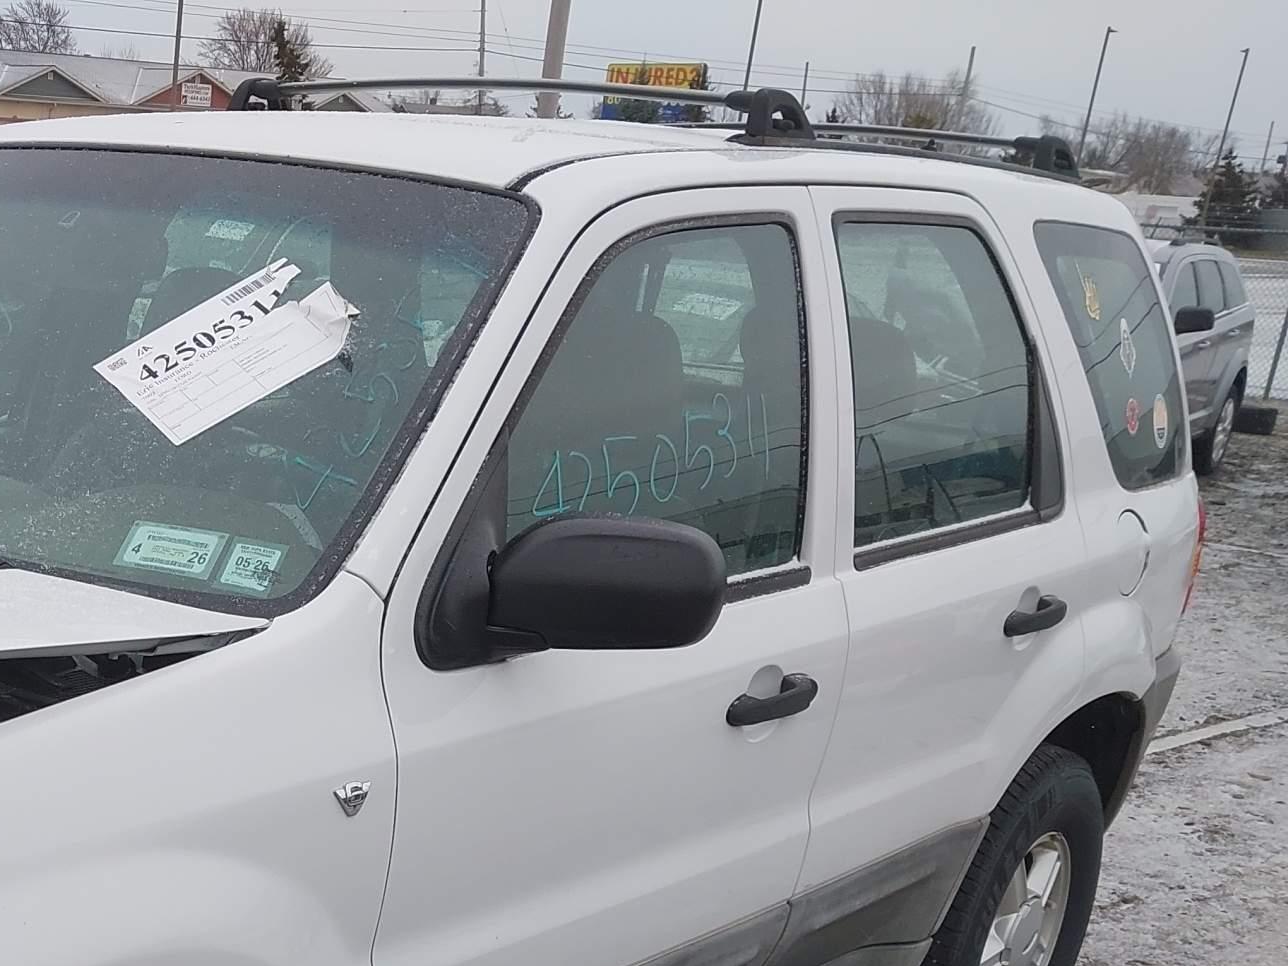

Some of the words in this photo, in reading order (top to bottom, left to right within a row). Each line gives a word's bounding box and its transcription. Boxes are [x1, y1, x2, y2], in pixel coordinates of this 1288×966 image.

[532, 392, 770, 516] 42505311
[131, 543, 143, 555] 4
[187, 551, 209, 565] 26
[235, 556, 252, 568] 05
[253, 559, 270, 571] 26
